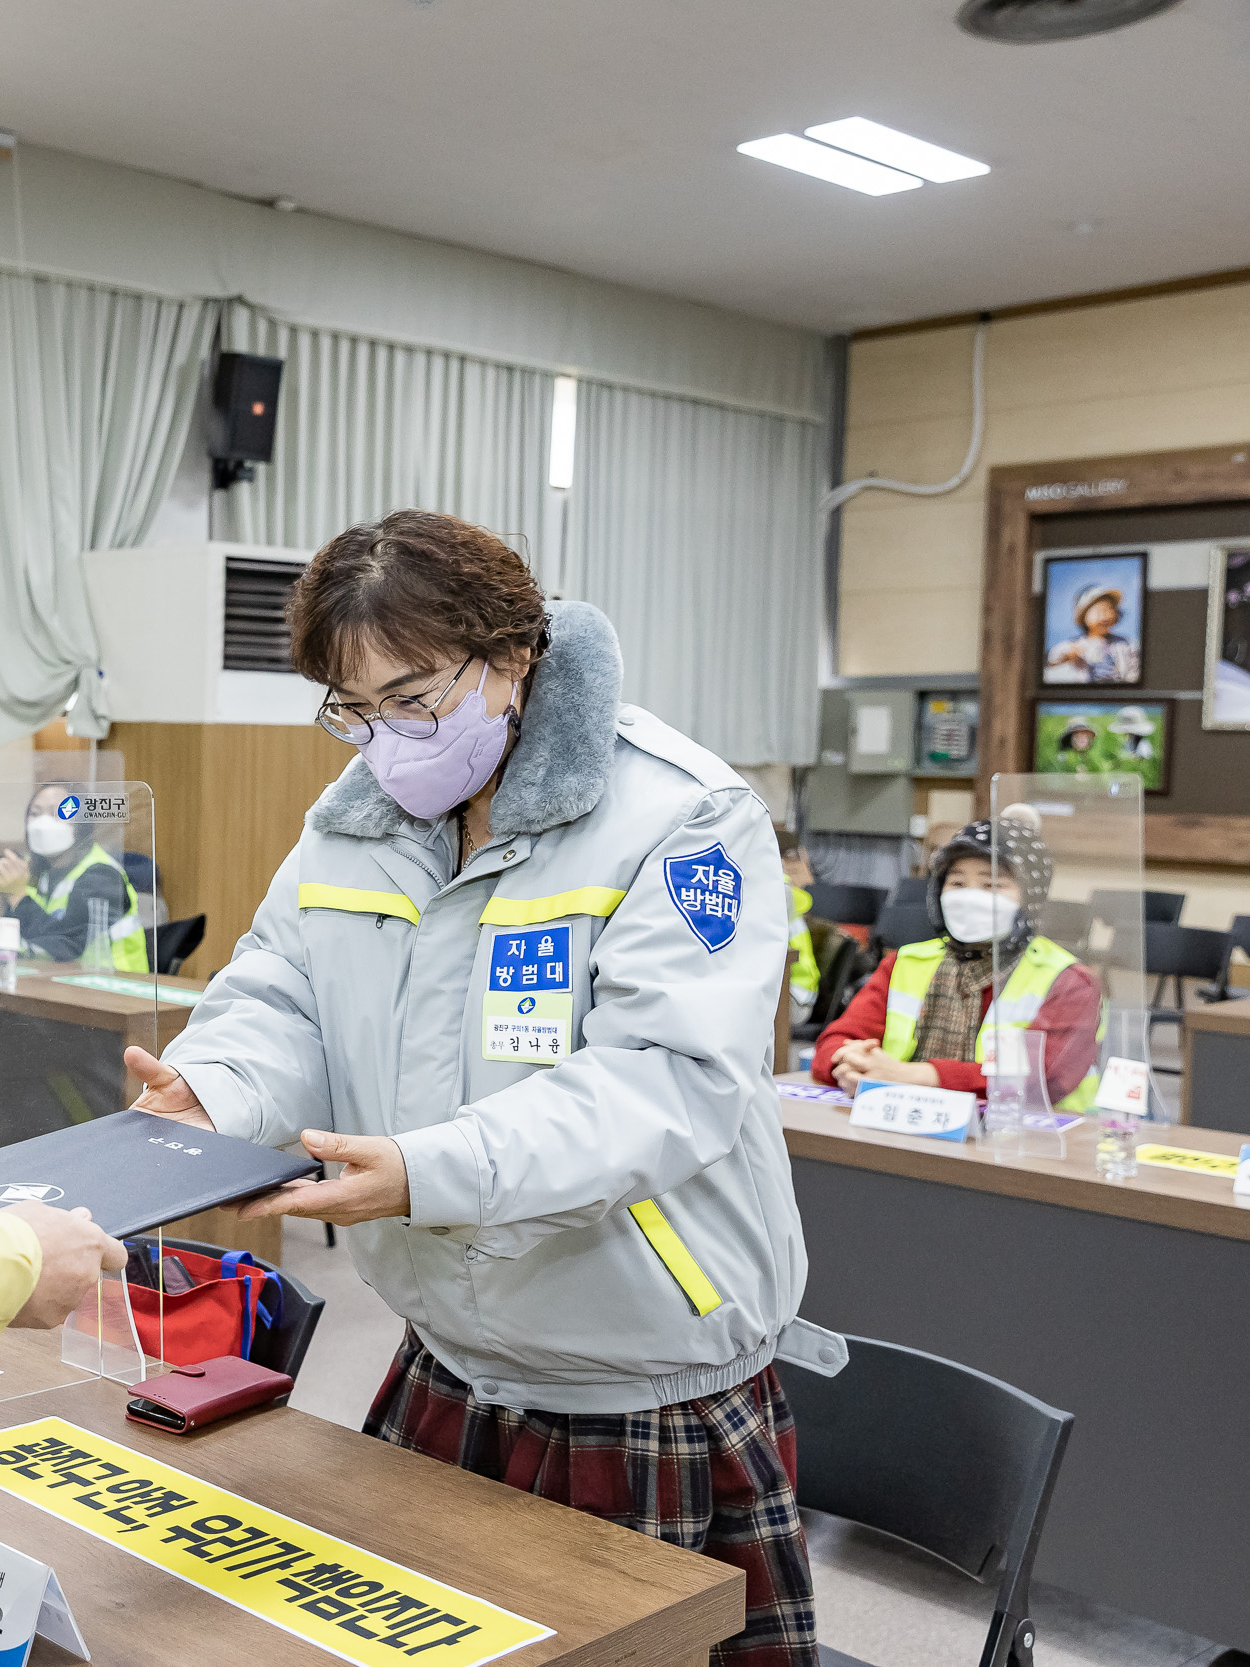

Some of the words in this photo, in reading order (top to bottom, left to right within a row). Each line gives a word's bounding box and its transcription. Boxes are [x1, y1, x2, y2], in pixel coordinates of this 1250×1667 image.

[1064, 478, 1128, 499] GALLERY
[84, 798, 126, 811] 광진구
[84, 811, 127, 819] GWANGJIN-GU
[690, 864, 736, 896] 자율
[680, 887, 738, 922] 방범대
[495, 962, 563, 987] 방범대
[493, 1024, 509, 1032] 광진구
[511, 1024, 529, 1033] 구의1동
[532, 1025, 558, 1034] 자율방범대
[73, 1478, 198, 1533] 안전,
[160, 1514, 315, 1579] 우리가
[276, 1562, 482, 1656] 책임진다
